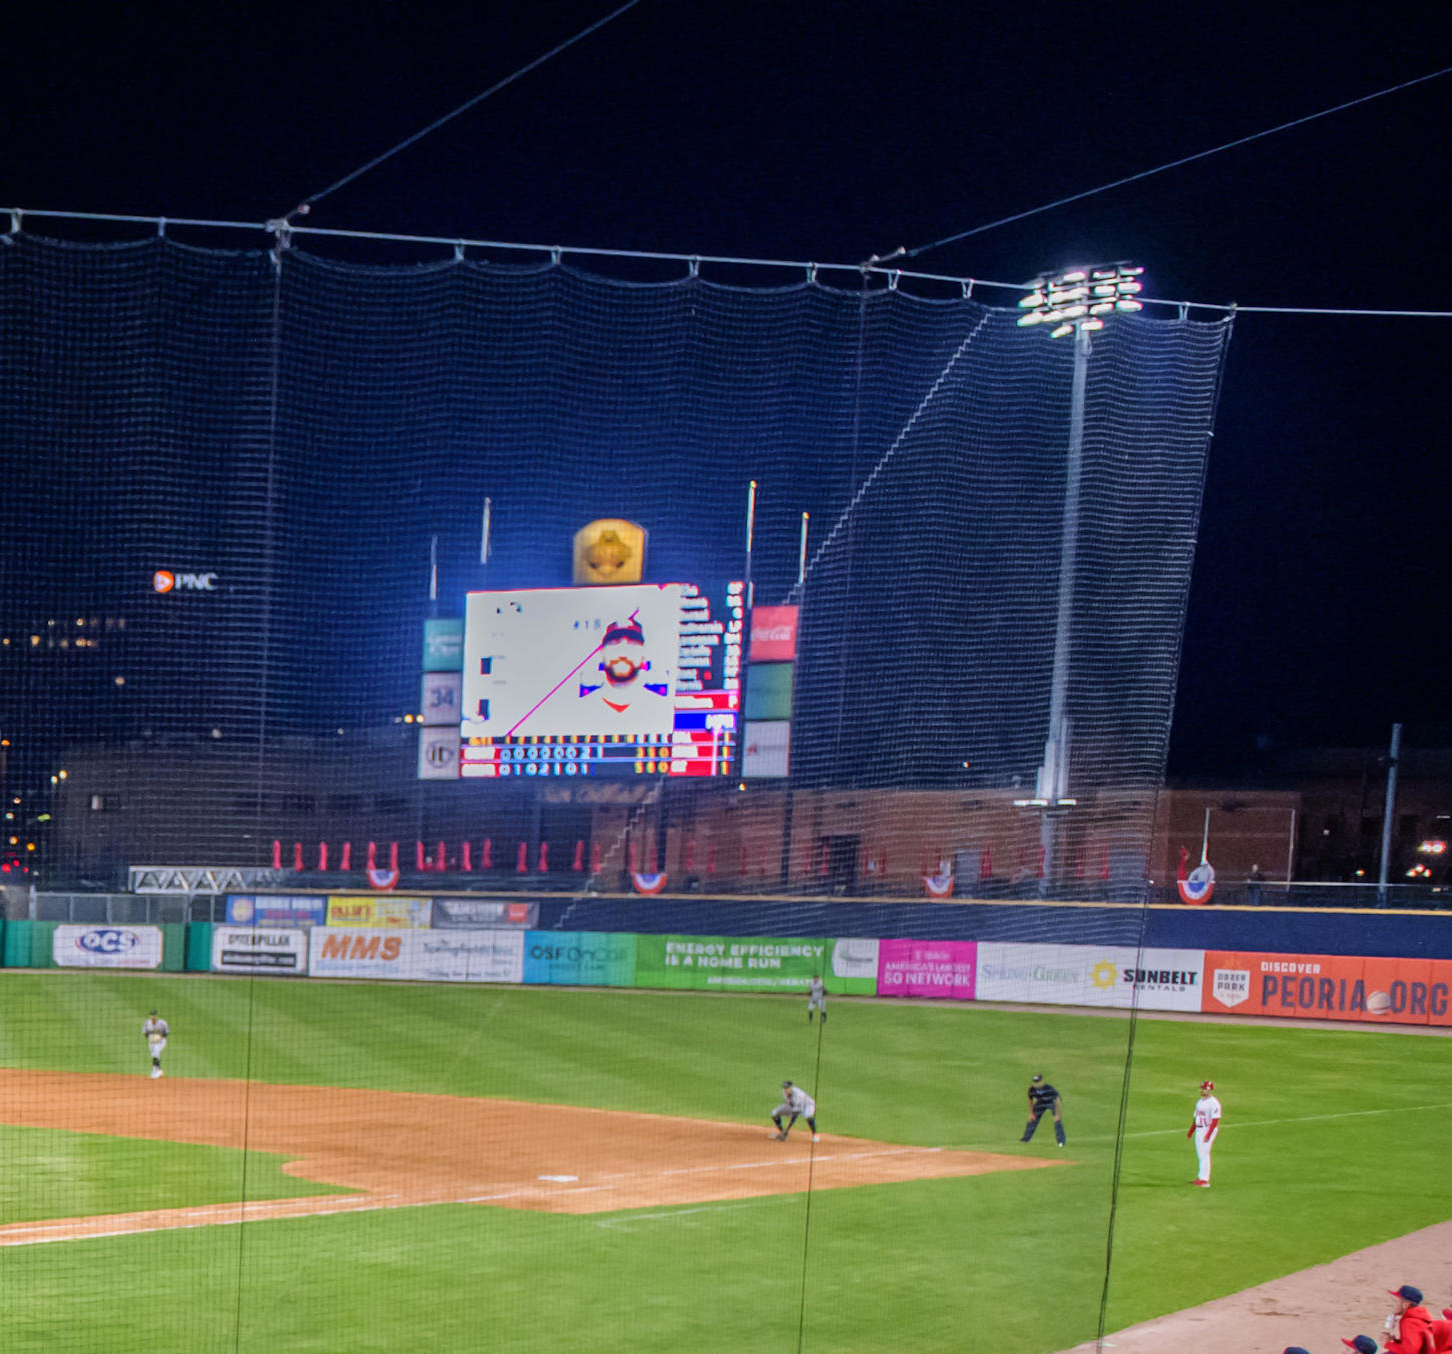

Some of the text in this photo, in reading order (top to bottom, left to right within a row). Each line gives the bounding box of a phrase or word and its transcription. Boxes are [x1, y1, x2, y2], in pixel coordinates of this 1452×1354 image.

[175, 572, 218, 590] PNC
[321, 934, 402, 960] MMS
[530, 944, 561, 960] OSF
[666, 942, 824, 958] ENERGY EFFICIENCY
[665, 955, 781, 969] IS A HOME RUN
[1260, 961, 1321, 974] DISCOVER
[884, 972, 970, 987] 5G NETWORK
[1123, 968, 1198, 985] SUNBELT
[1132, 984, 1185, 992] RENTALS
[1217, 982, 1245, 991] PARK
